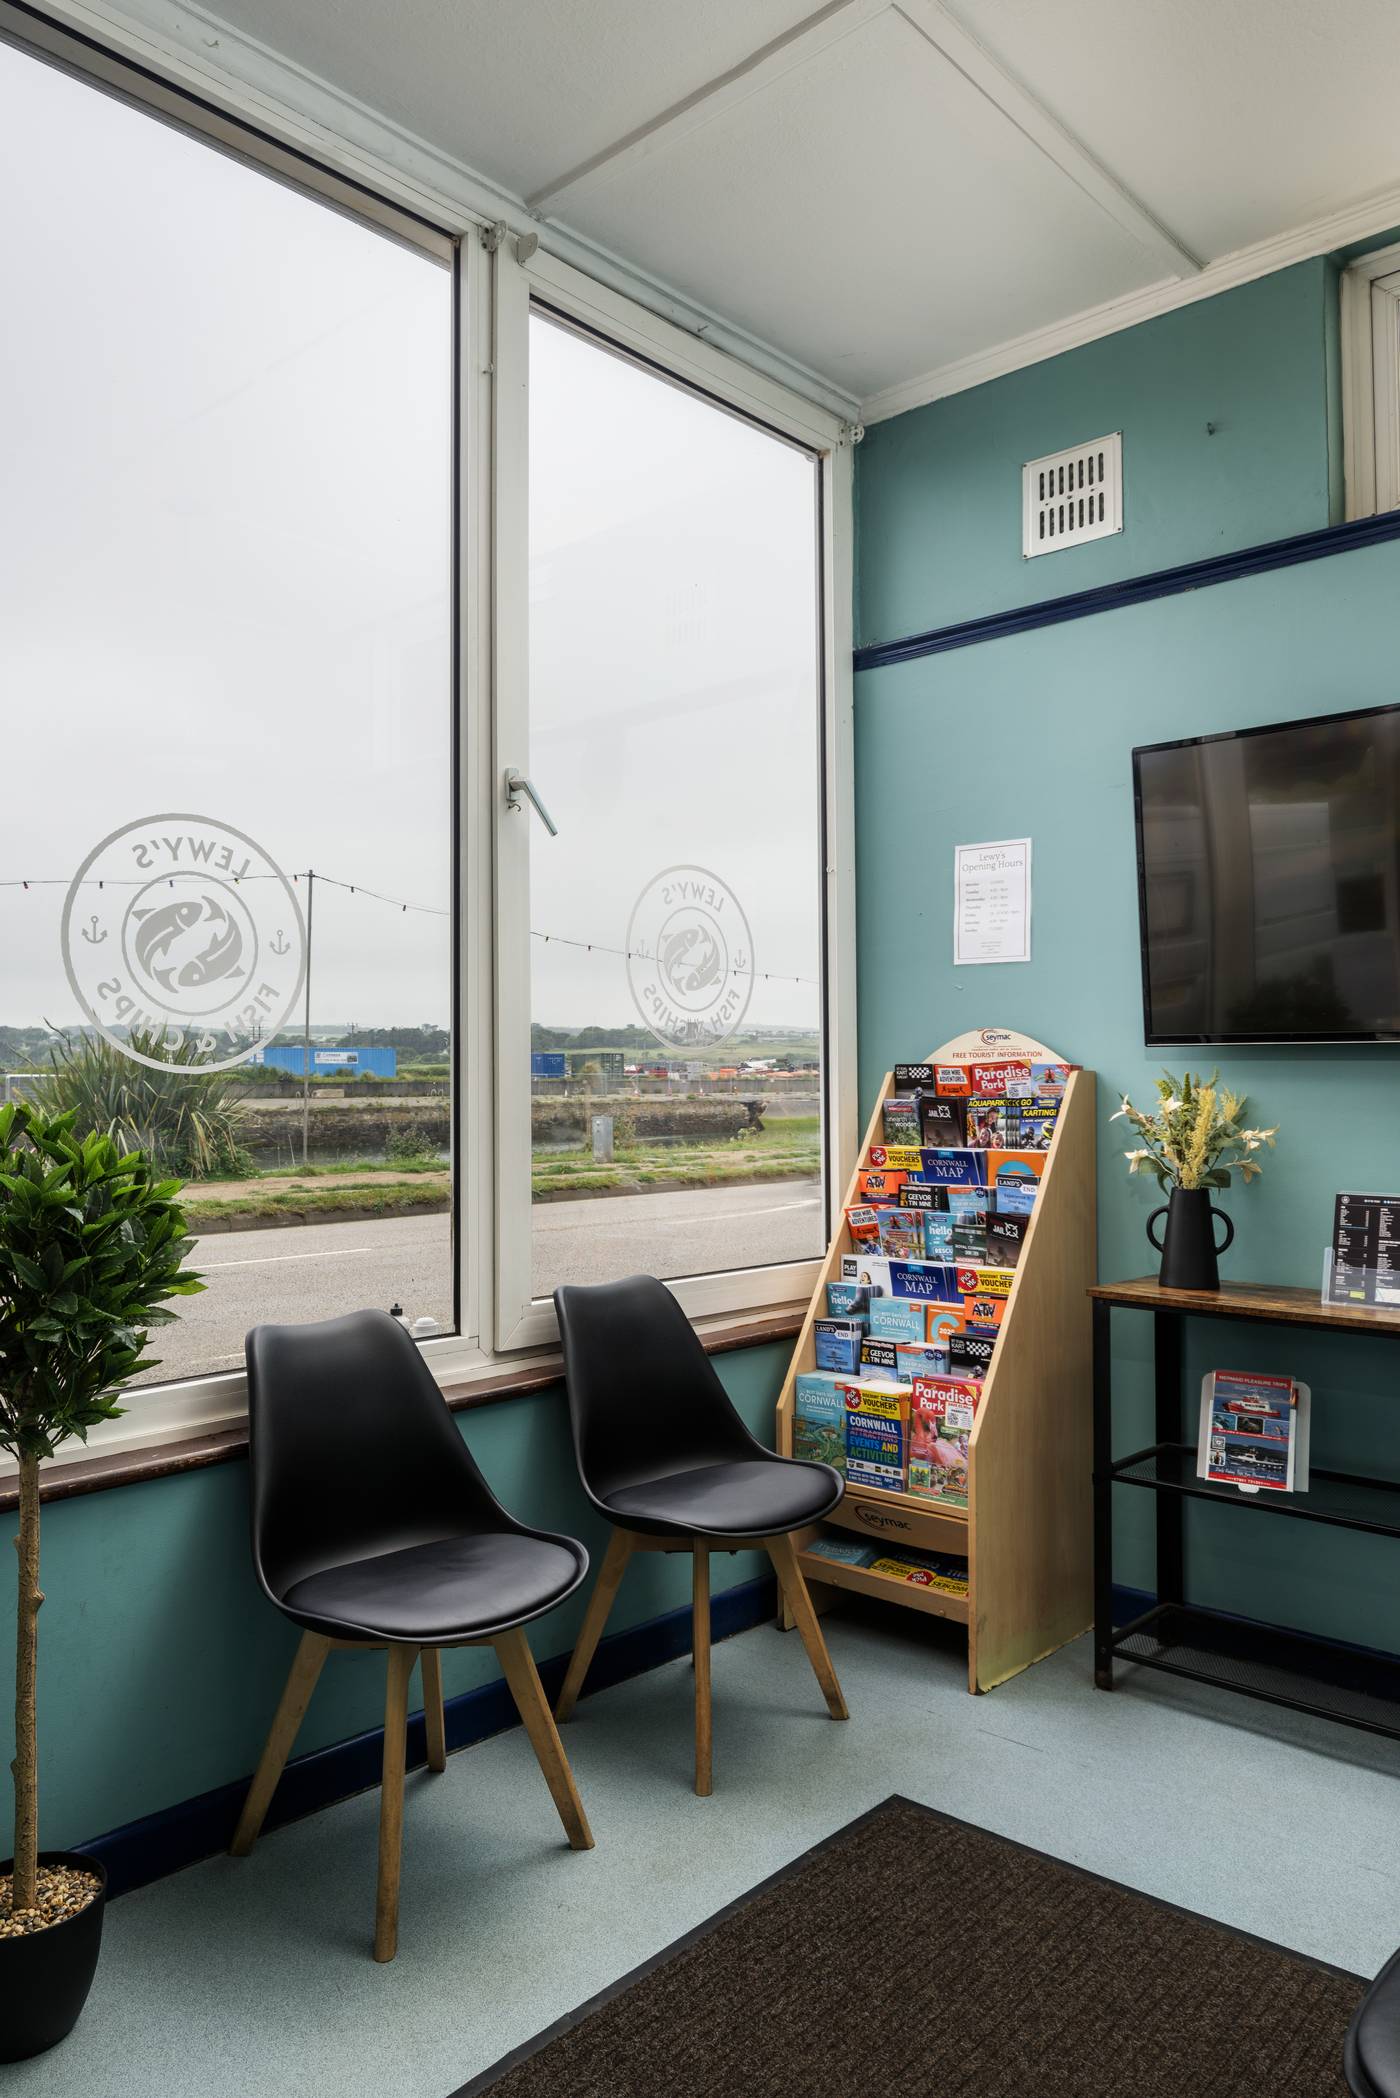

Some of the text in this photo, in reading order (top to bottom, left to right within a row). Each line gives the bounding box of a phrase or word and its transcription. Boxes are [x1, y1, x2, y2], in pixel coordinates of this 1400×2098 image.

[962, 859, 1023, 872] Opening Hours
[986, 1034, 1012, 1043] seymac
[975, 1066, 1029, 1081] Paradise
[981, 1079, 1005, 1090] Park
[968, 1099, 1005, 1107] AQUAPARK
[1023, 1109, 1057, 1117] KARTING!
[889, 1155, 920, 1163] VOUCHERS
[928, 1159, 968, 1168] CORNWALL
[935, 1166, 964, 1178] MAP
[999, 1179, 1020, 1187] LAND'S
[929, 1226, 952, 1235] hello
[897, 1273, 938, 1284] CORNWALL
[980, 1279, 1012, 1288] VOUCHER
[905, 1281, 933, 1295] MAP
[830, 1295, 853, 1305] hello
[873, 1315, 920, 1329] CORNWALL
[816, 1325, 835, 1333] LAND'S
[870, 1349, 895, 1359] GEEVOR
[915, 1382, 973, 1405] Paradise
[799, 1391, 844, 1409] CORNWALL
[863, 1398, 897, 1410] VOUCHERS
[920, 1397, 944, 1411] Park
[850, 1415, 897, 1434] CORNWALL
[850, 1435, 899, 1453] EVENTS AND
[850, 1446, 899, 1464] ACTIVITIES
[864, 1513, 912, 1531] seymac
